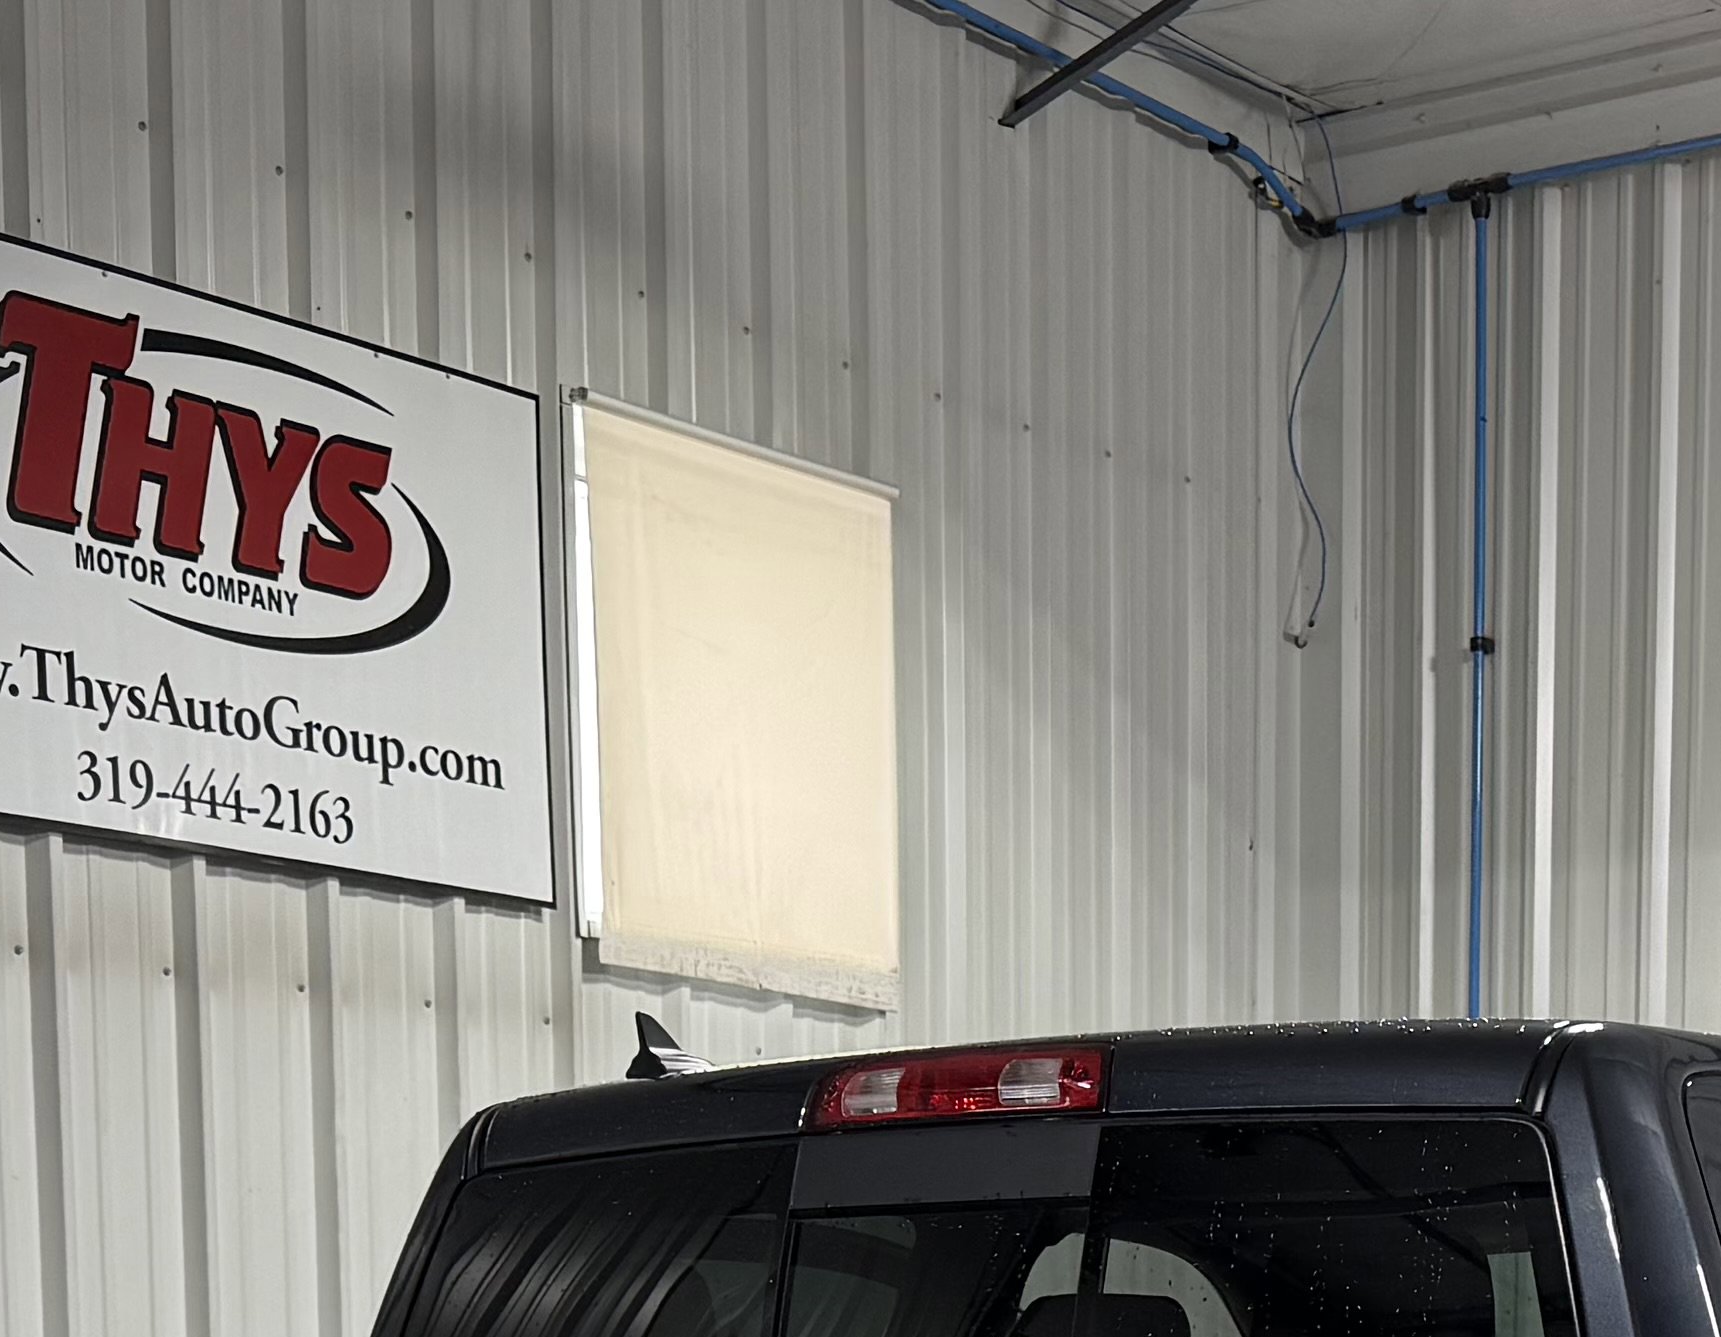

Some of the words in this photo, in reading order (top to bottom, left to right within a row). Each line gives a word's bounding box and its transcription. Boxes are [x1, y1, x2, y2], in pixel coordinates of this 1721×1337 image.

[74, 542, 166, 589] MOTOR
[182, 567, 298, 617] COMPANY
[76, 750, 355, 845] 319-444-2163
